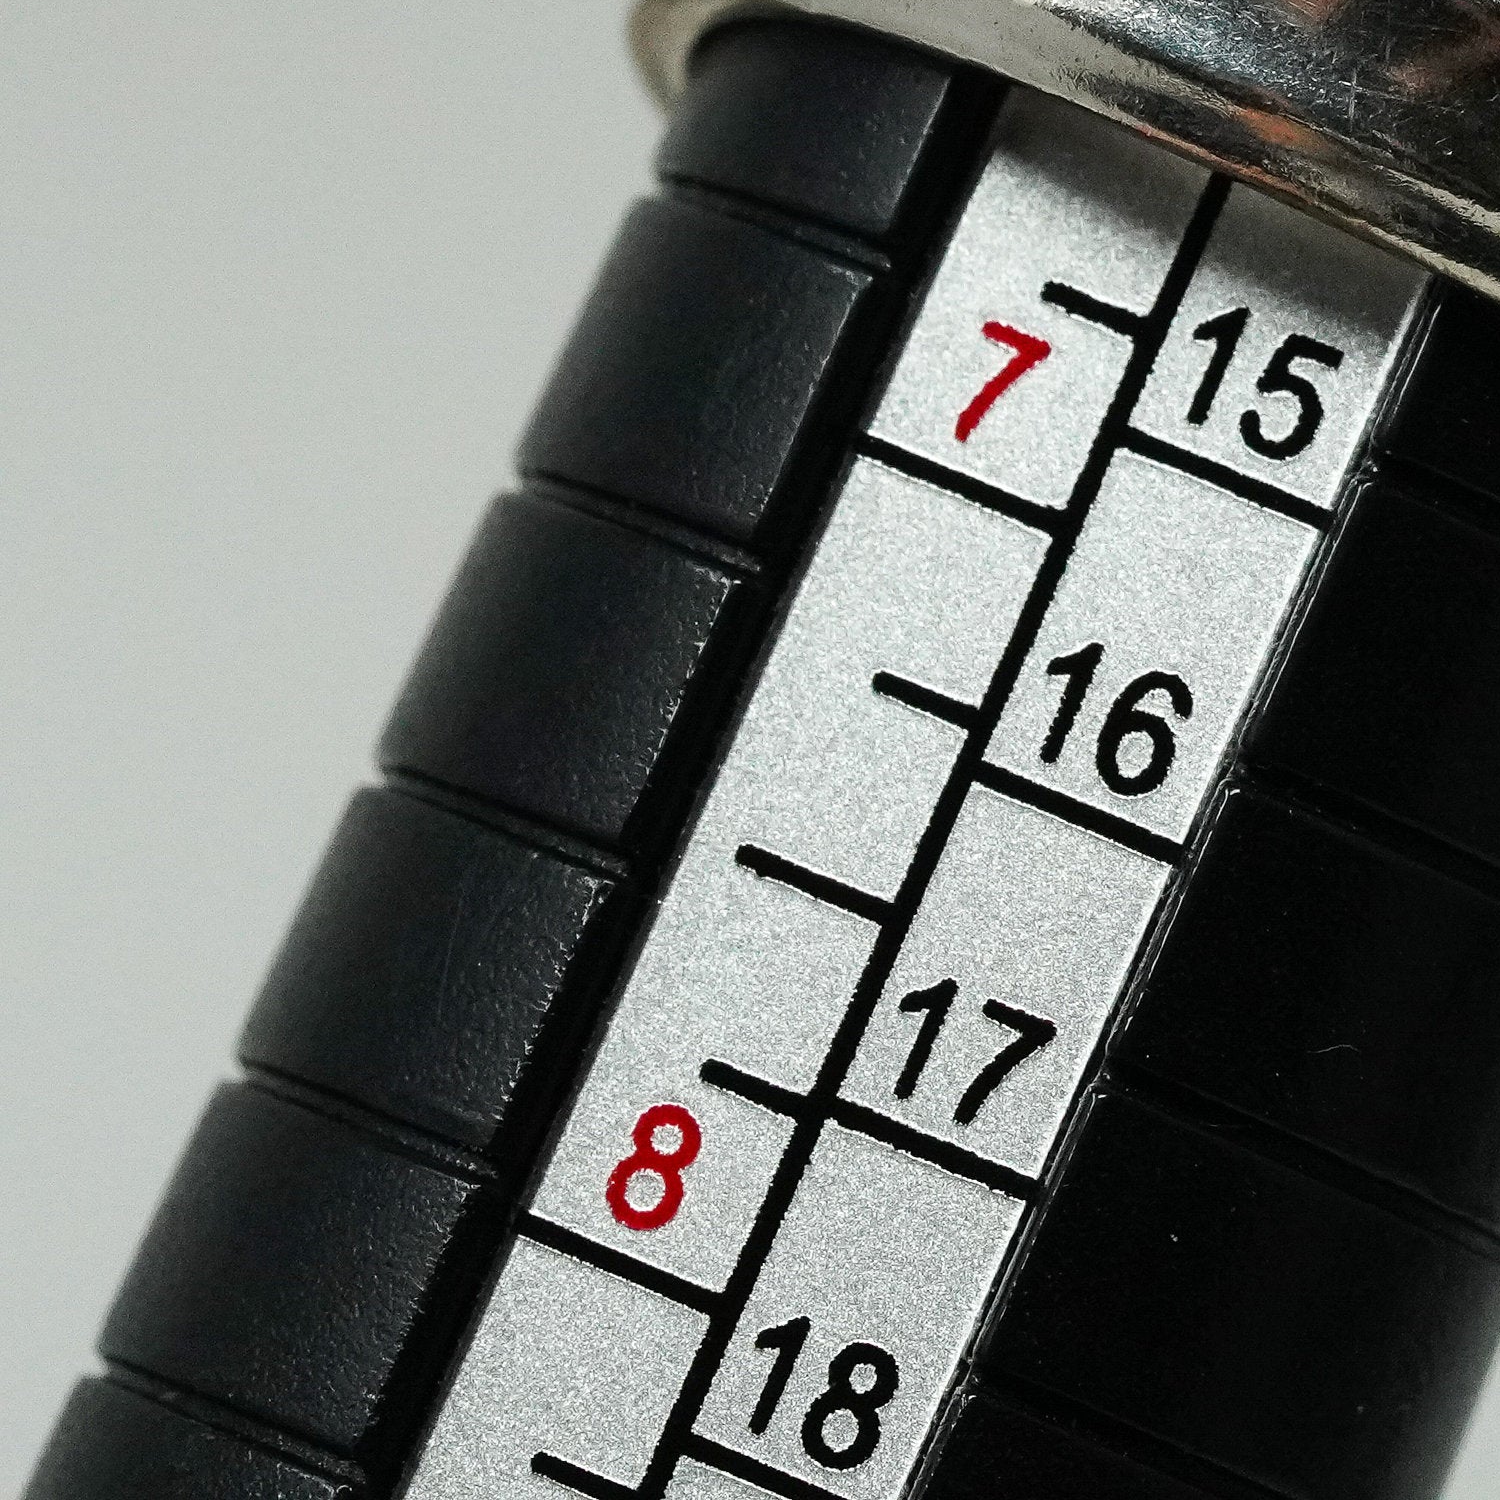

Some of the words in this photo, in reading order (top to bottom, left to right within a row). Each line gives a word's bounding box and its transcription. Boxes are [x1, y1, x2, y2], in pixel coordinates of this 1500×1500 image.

[954, 320, 1053, 444] 7
[1185, 305, 1346, 463] 15
[1038, 641, 1195, 799] 16
[892, 976, 1059, 1130] 17
[604, 1103, 703, 1233] 8
[746, 1314, 902, 1474] 18
